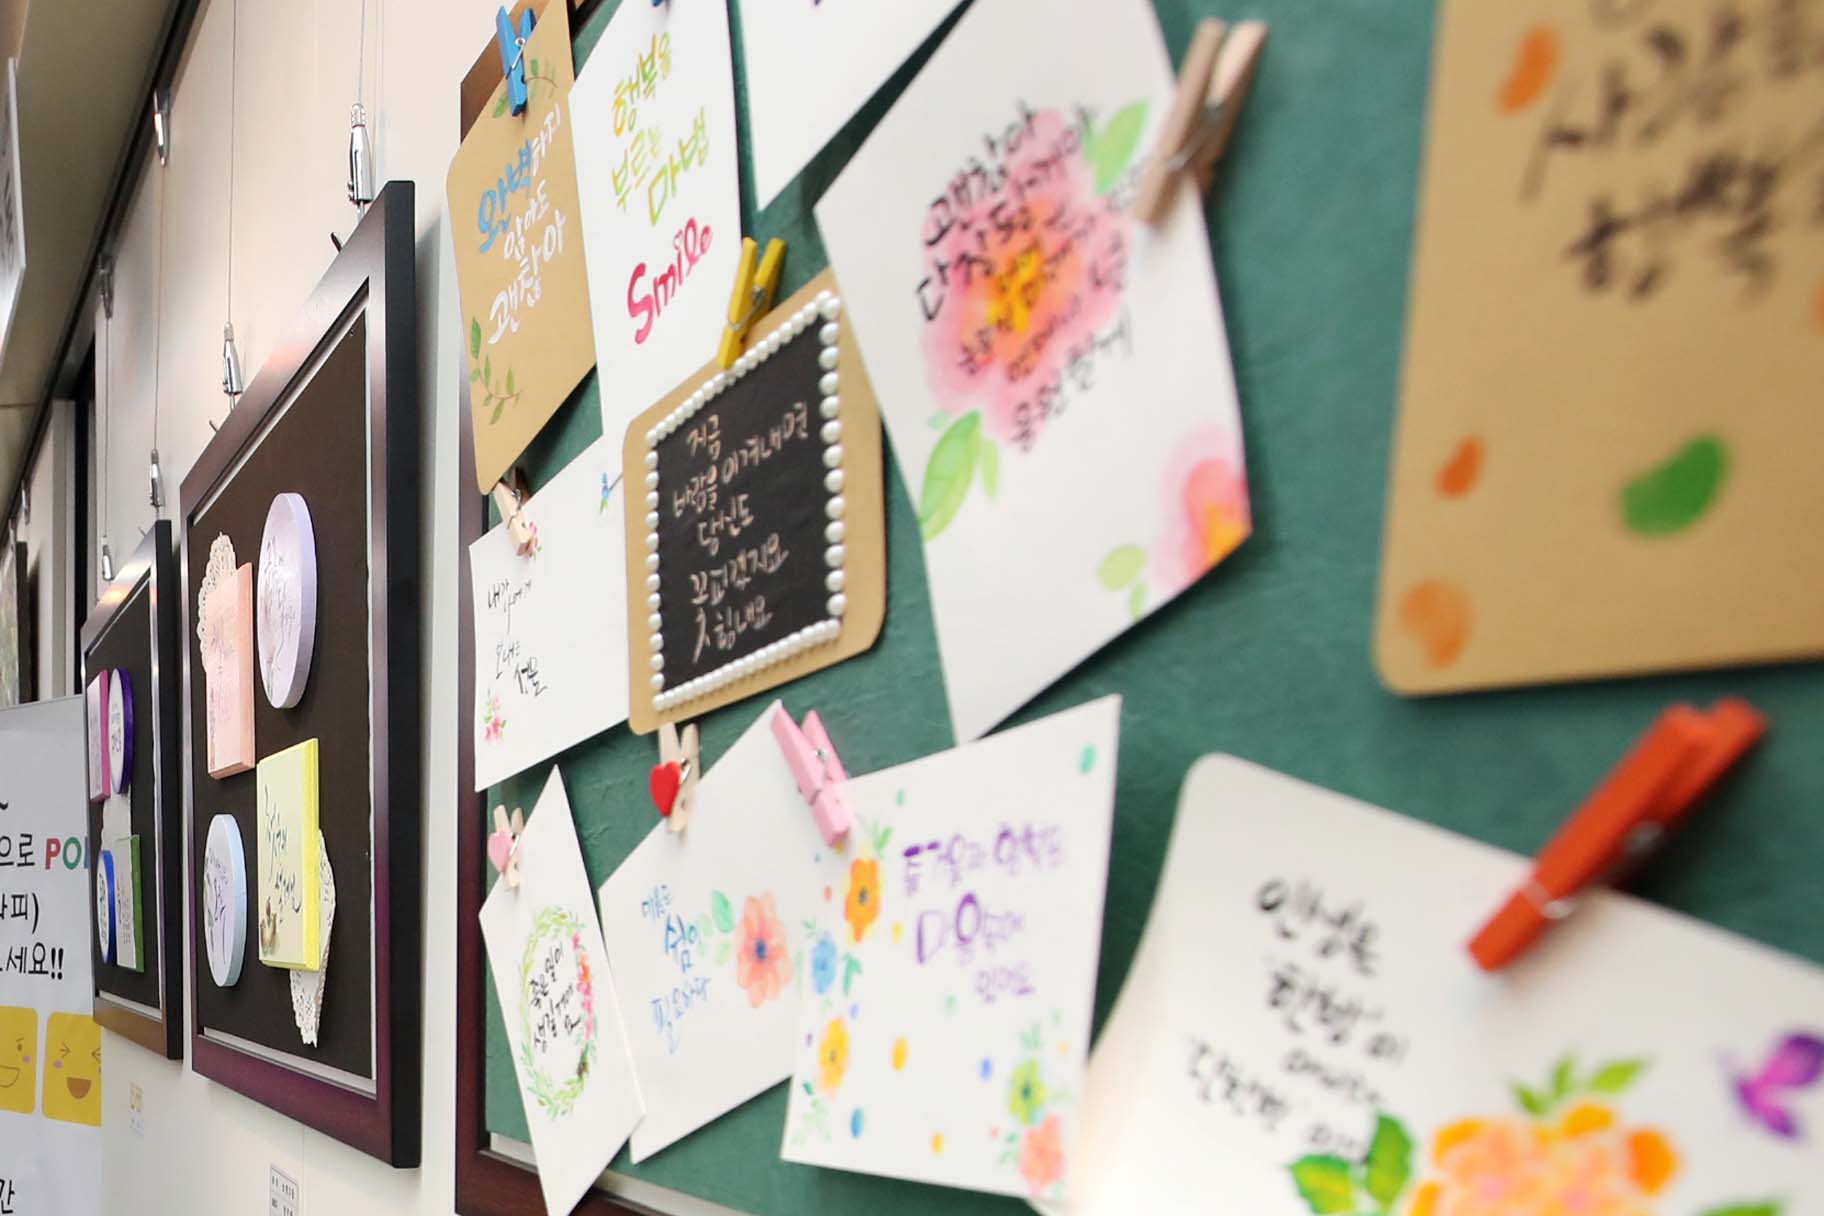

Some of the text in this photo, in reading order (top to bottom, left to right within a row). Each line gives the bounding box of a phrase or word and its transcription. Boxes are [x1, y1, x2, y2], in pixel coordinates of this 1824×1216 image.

[612, 31, 672, 137] 행복을
[478, 102, 561, 254] 완벽하지
[504, 180, 549, 262] 않아도
[488, 212, 566, 345] 괜찮아
[626, 217, 713, 345] Smile
[686, 413, 722, 461] 지금
[697, 492, 755, 556] 당신도
[44, 836, 88, 870] PO
